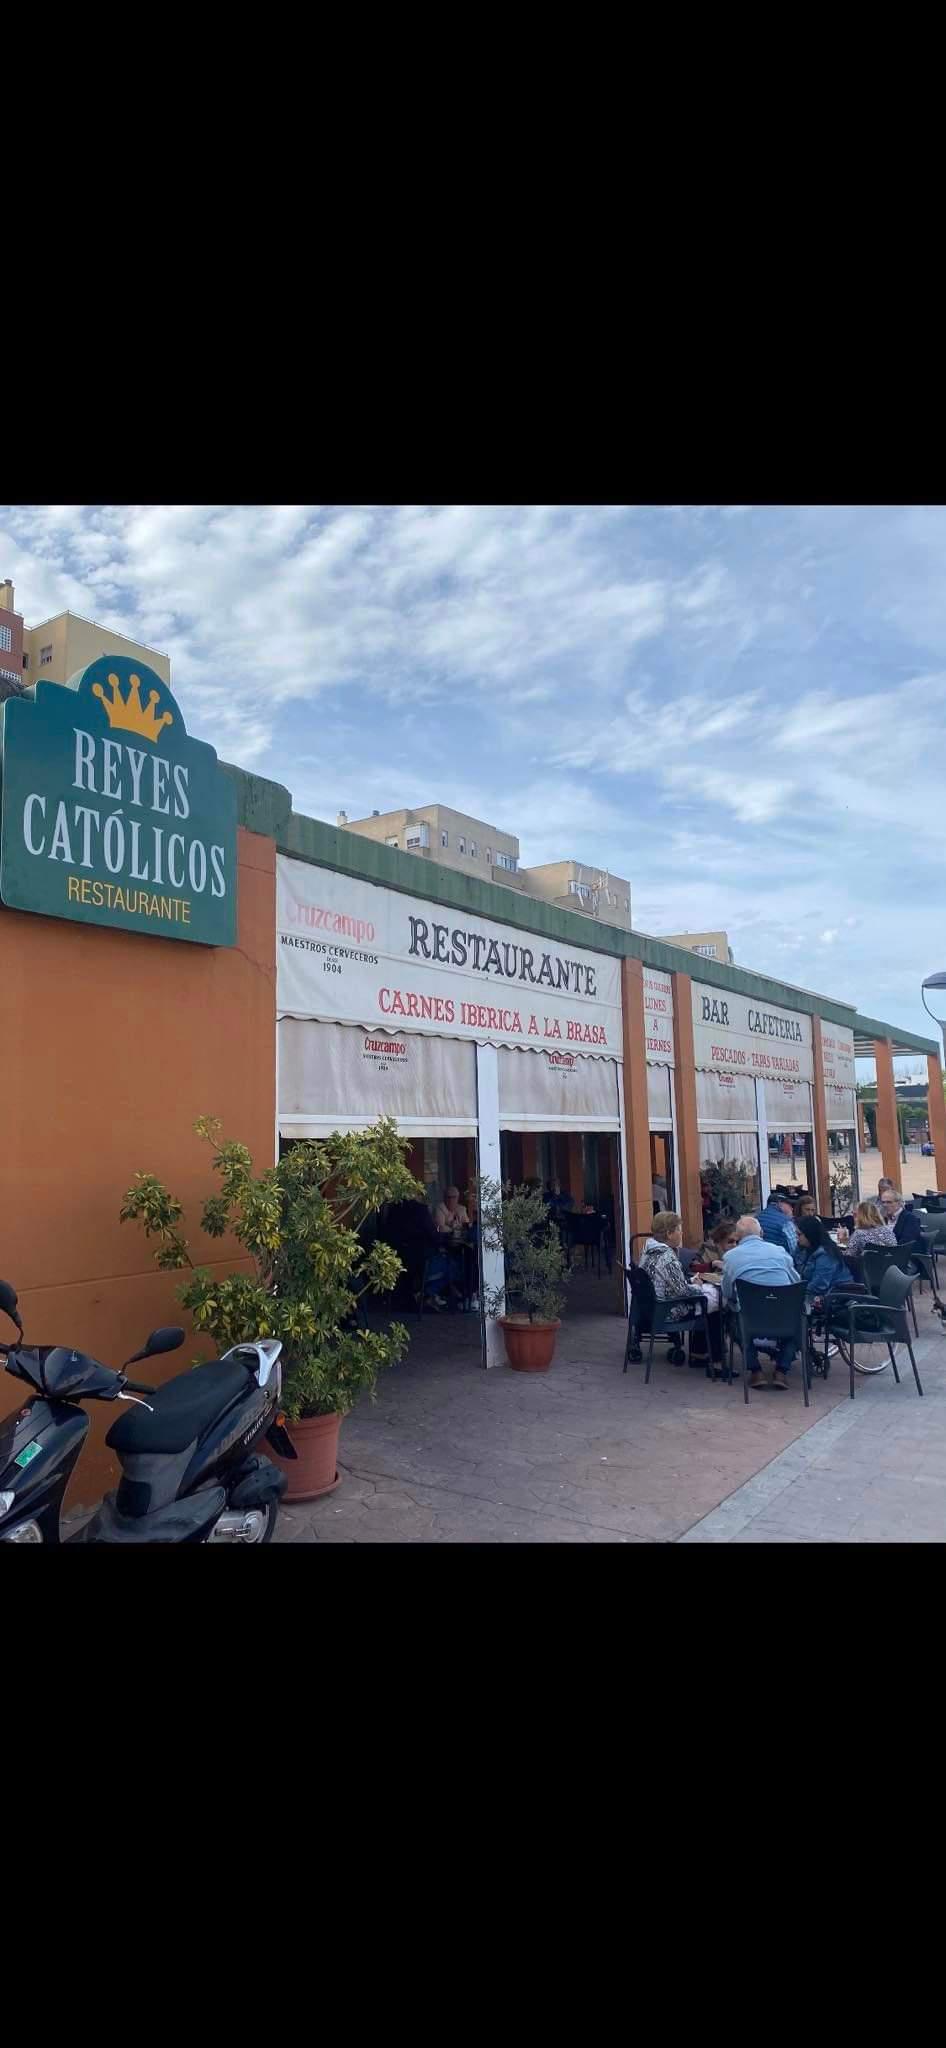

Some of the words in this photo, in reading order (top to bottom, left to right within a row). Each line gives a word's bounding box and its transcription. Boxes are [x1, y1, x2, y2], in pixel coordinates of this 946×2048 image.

[71, 728, 190, 820] REYES
[23, 793, 227, 898] CATÓLICOS
[68, 876, 192, 924] RESTAURANTE
[285, 898, 375, 944] Cruzcampo
[280, 935, 327, 954] MAESTROS
[328, 946, 379, 965] CERVECEROS
[323, 962, 342, 974] 1904
[408, 915, 598, 997] RESTAURANTE
[378, 987, 456, 1023] CARNES
[460, 1002, 522, 1034] IBERICA
[527, 1014, 541, 1035] A
[543, 1016, 563, 1039] LA
[566, 1020, 608, 1046] BRASA
[645, 997, 667, 1012] LUNES
[701, 996, 730, 1026] BAR
[747, 1009, 803, 1042] CAFETERIA
[652, 1018, 659, 1031] A
[364, 1036, 406, 1056] Cruzcampo
[647, 1038, 672, 1053] IERNES
[711, 1045, 746, 1065] PESCADOS
[751, 1052, 771, 1069] TAPAS
[771, 1056, 799, 1073] VARIADAS
